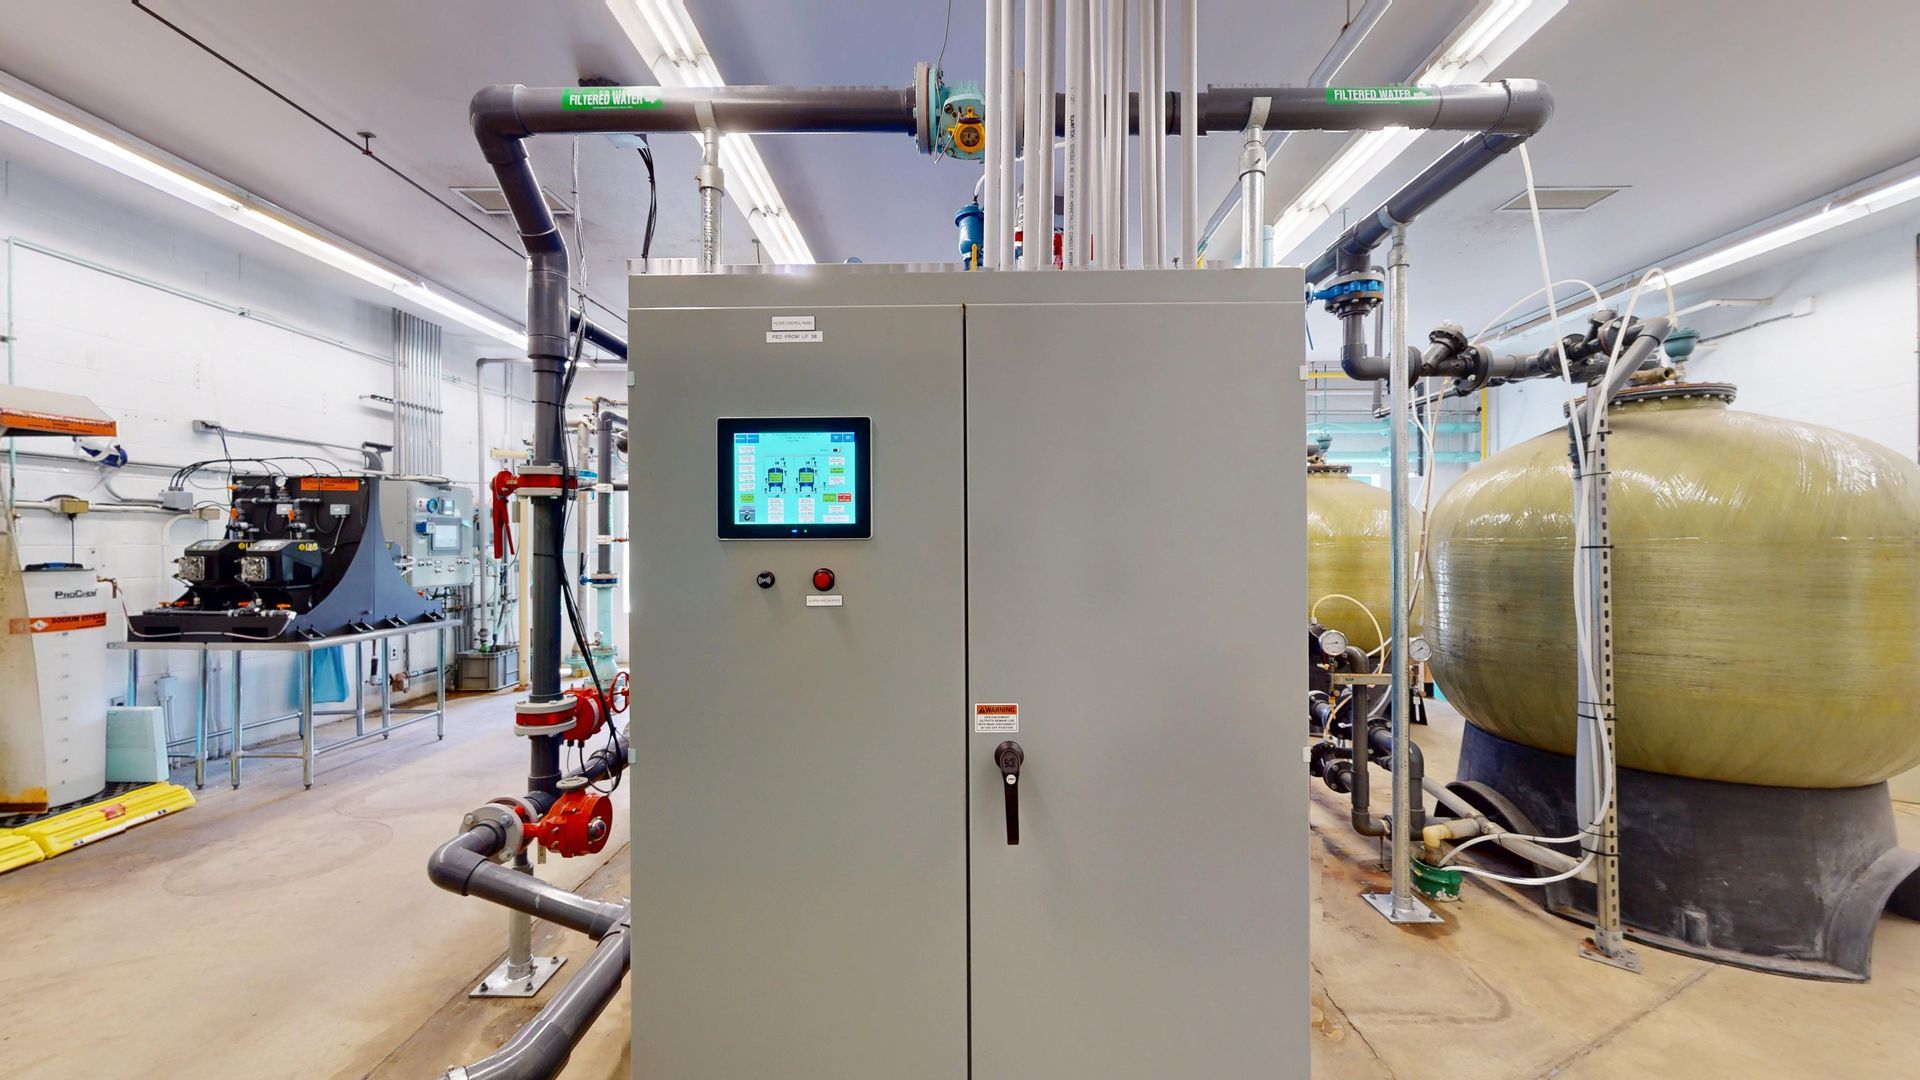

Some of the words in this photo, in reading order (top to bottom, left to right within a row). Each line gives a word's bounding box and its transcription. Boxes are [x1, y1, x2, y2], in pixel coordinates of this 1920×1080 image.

[569, 92, 610, 105] FILTERED
[612, 90, 643, 105] WATER
[1334, 89, 1377, 100] FILTERED
[1378, 89, 1411, 100] WATER
[51, 615, 80, 624] SODIUM
